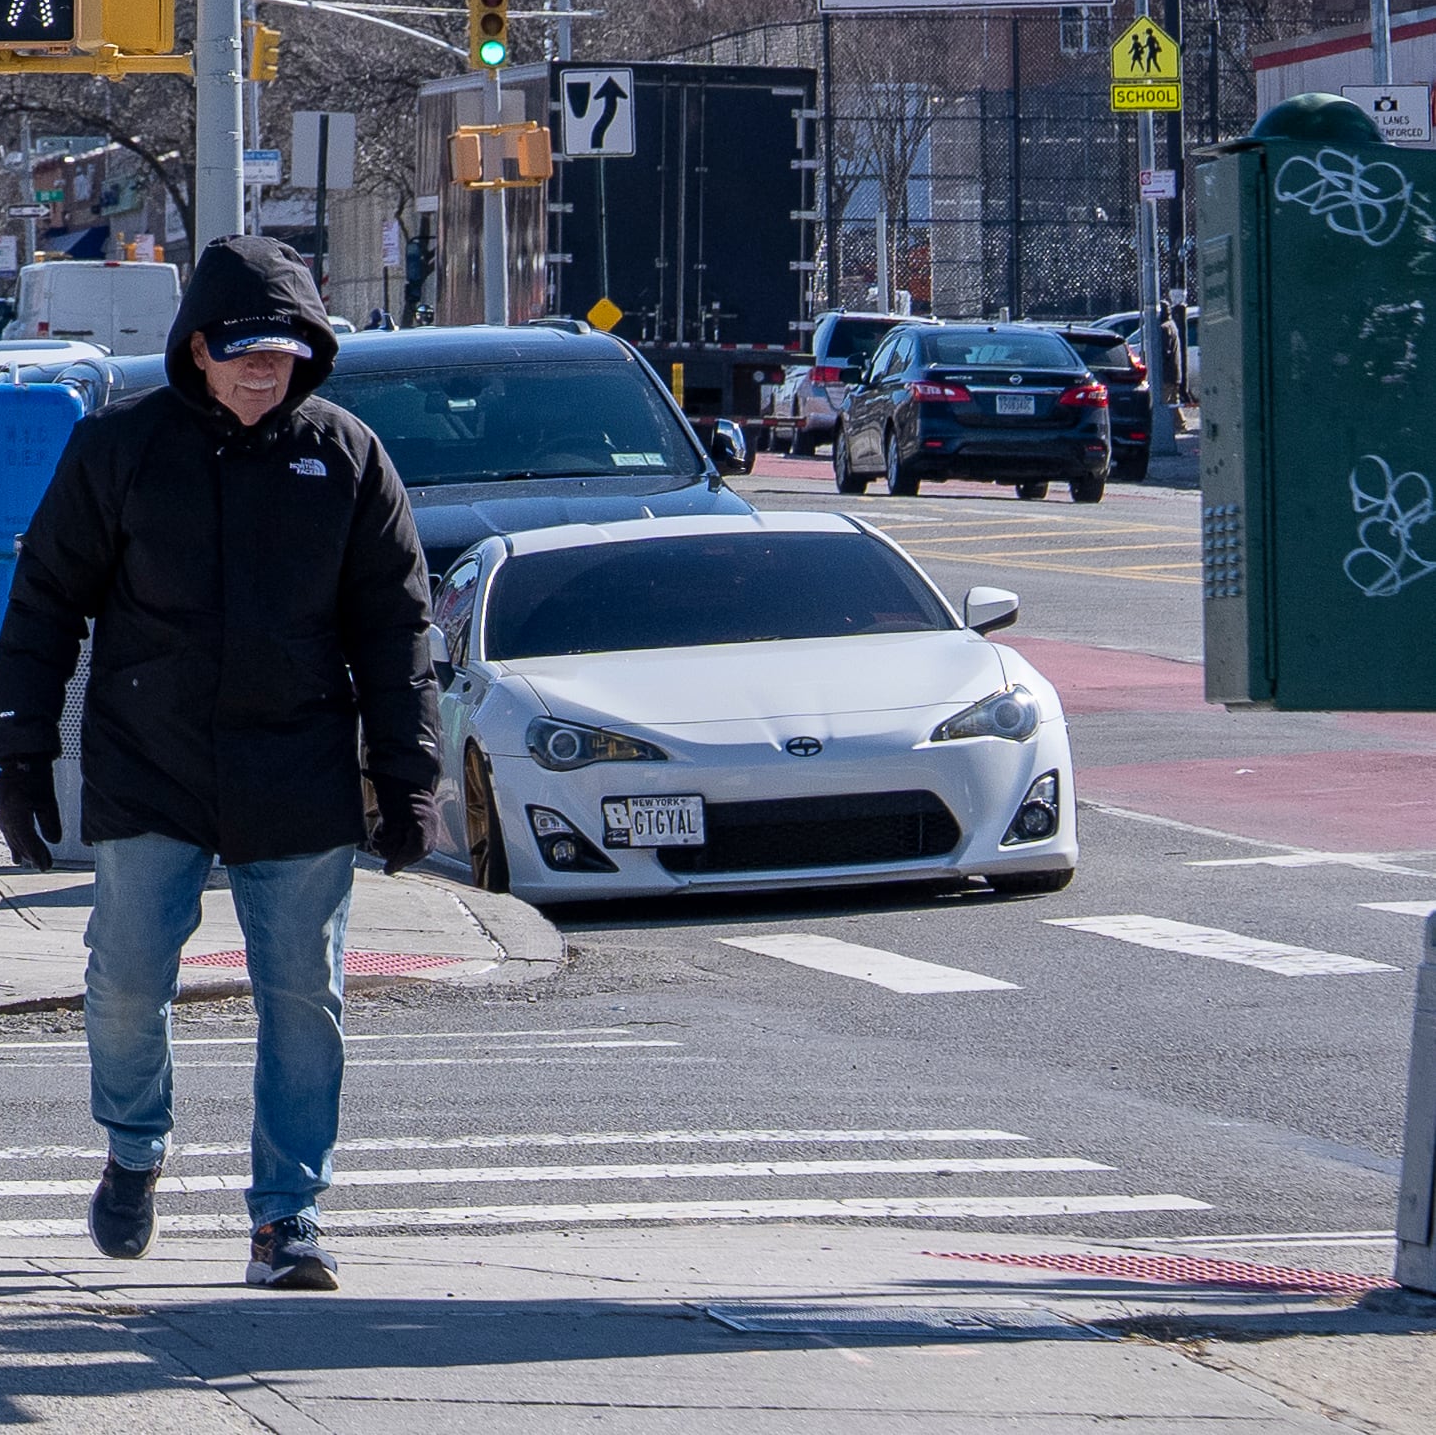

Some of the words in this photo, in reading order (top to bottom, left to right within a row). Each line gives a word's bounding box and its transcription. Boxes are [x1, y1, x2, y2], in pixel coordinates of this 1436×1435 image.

[1116, 90, 1175, 103] SCHOOL
[1383, 115, 1410, 125] LANES
[632, 799, 652, 807] NEW
[656, 798, 680, 807] YORK
[634, 808, 698, 836] GTGYAL
